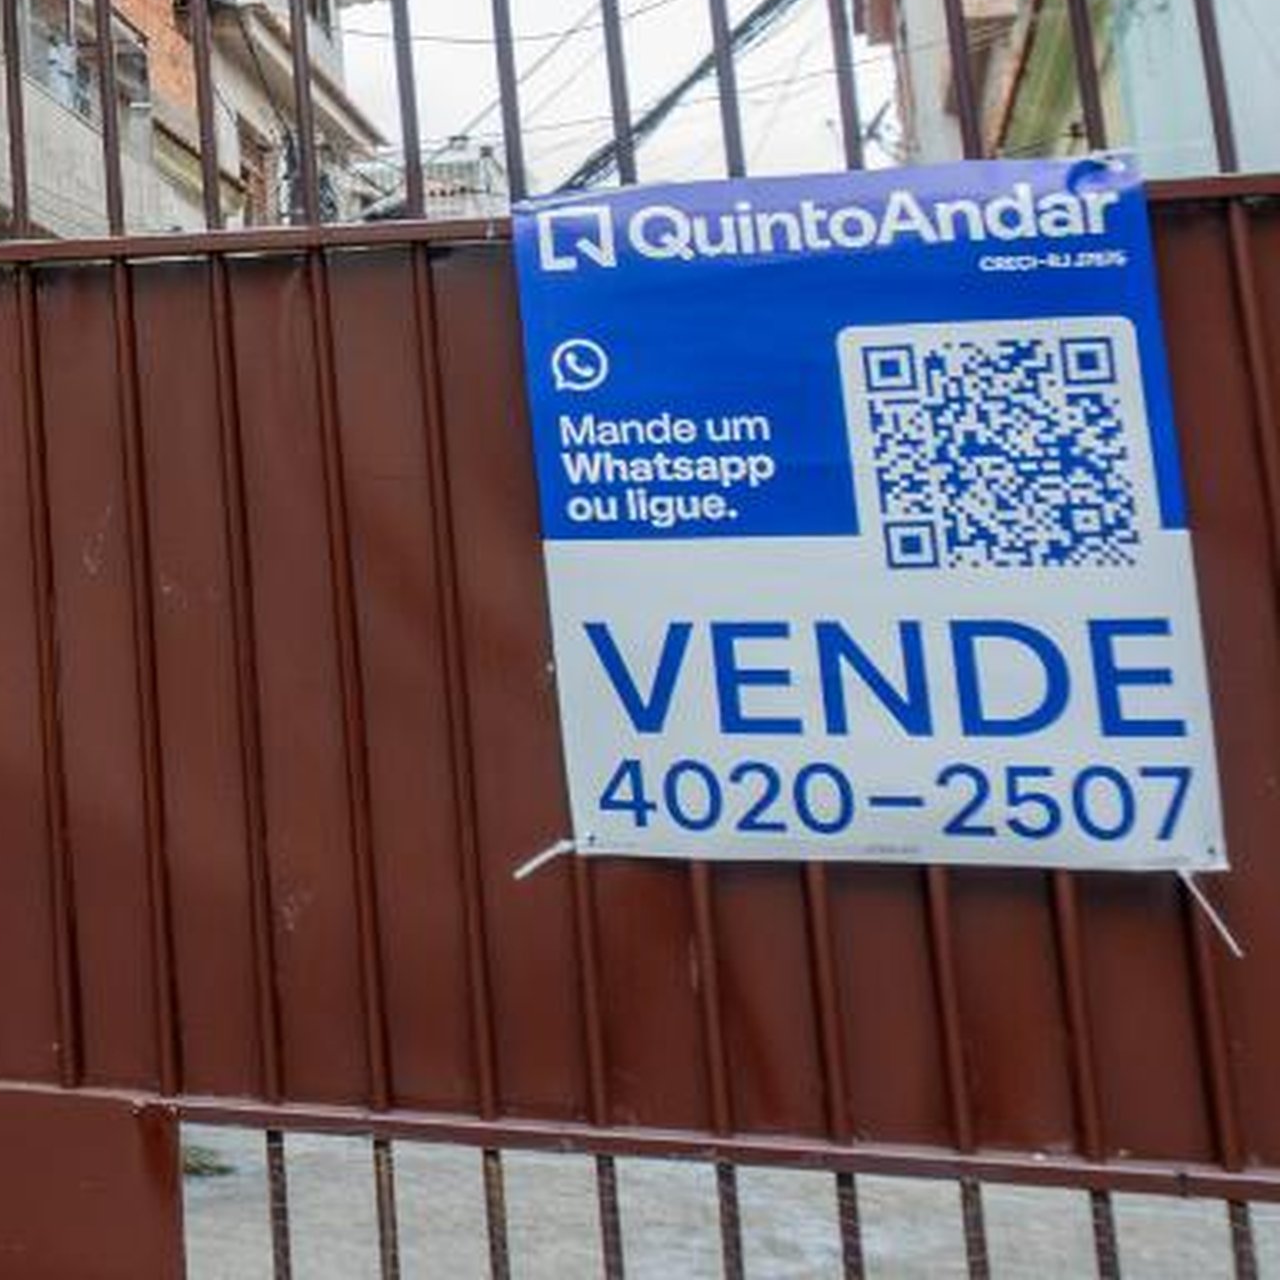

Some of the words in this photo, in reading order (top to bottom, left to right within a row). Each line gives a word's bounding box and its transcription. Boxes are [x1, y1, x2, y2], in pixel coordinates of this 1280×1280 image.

[628, 183, 1118, 261] QuintoAndar
[559, 412, 696, 447] Mande
[705, 414, 771, 442] um
[560, 451, 775, 488] Whatsapp
[567, 495, 618, 521] ou
[626, 487, 738, 528] ligue.
[583, 617, 1189, 738] VENDE
[598, 758, 1193, 842] 4020-2507
